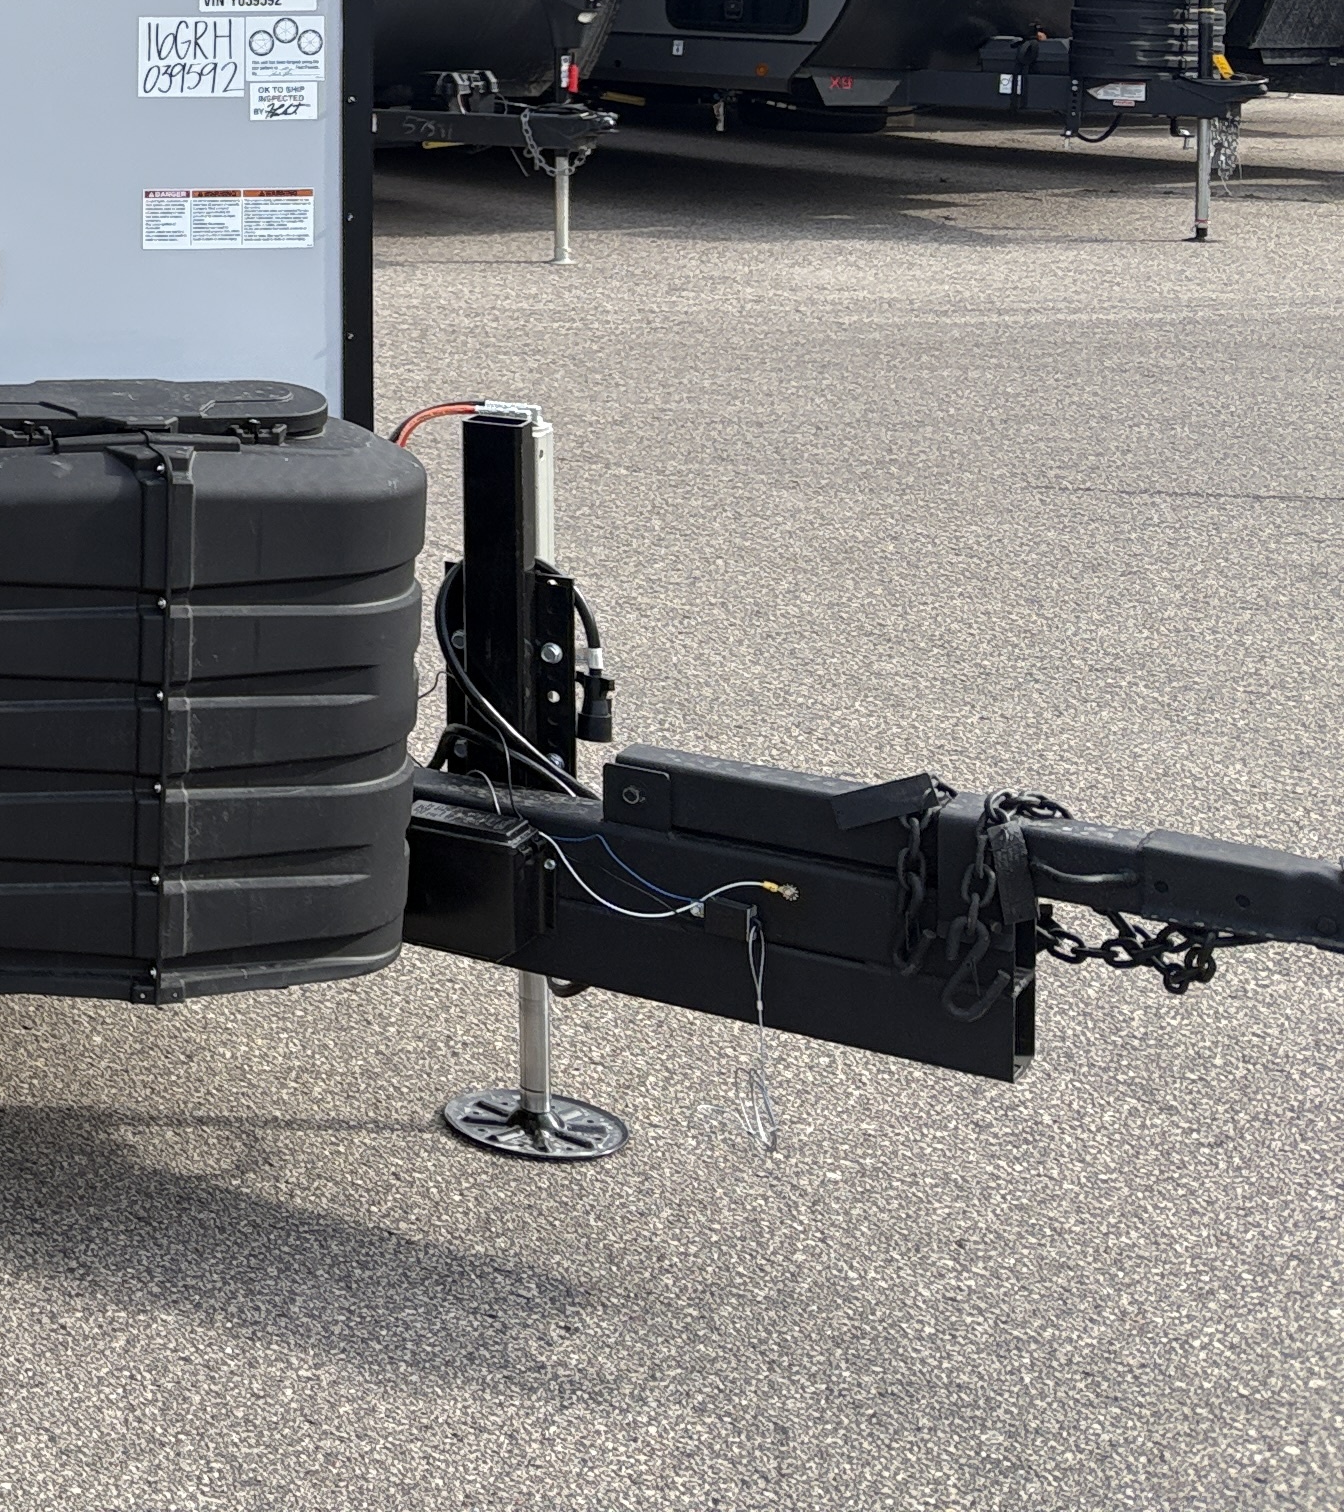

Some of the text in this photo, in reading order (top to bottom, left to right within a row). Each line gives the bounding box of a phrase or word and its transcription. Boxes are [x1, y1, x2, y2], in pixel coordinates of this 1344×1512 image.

[147, 19, 233, 61] 16GRH
[143, 61, 244, 93] 039592
[258, 86, 270, 94] OK
[272, 86, 284, 94] TO
